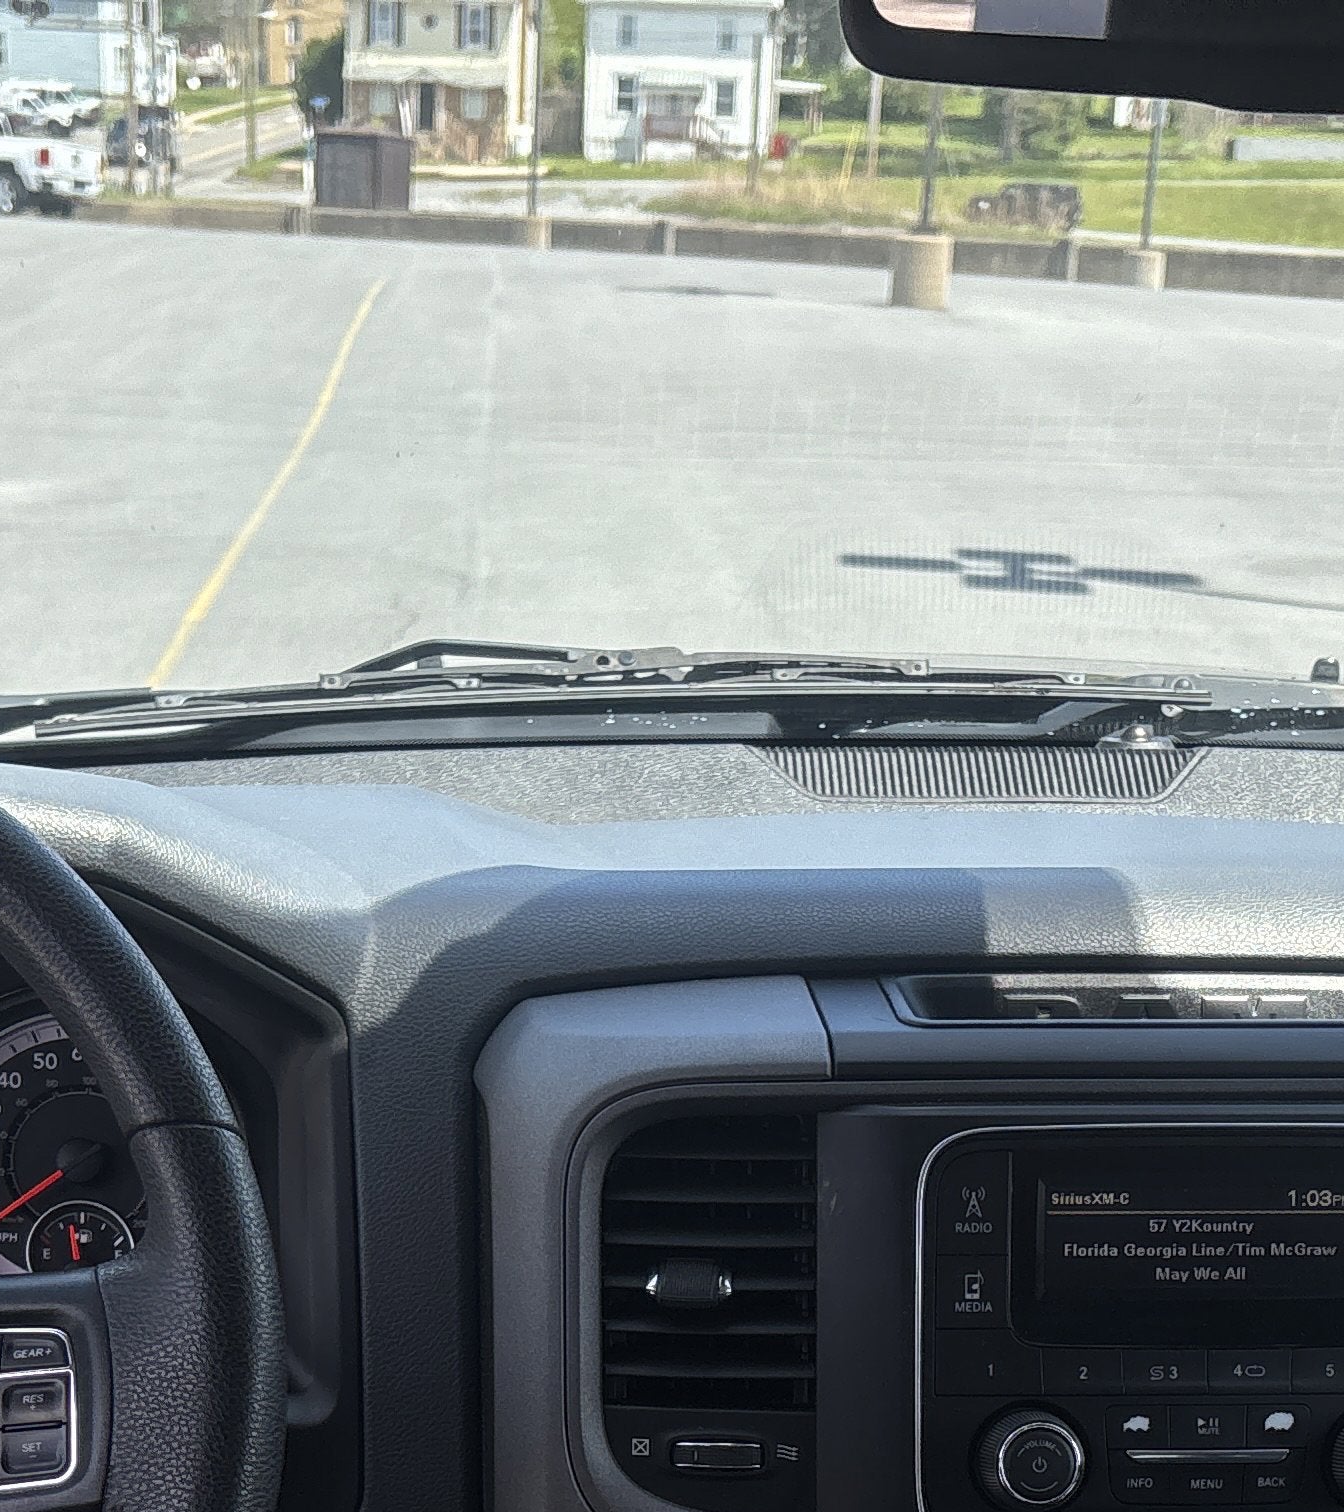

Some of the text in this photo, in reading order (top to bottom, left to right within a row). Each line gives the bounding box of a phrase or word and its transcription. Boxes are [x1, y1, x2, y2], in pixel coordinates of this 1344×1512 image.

[33, 1052, 58, 1070] 50
[1051, 1192, 1130, 1205] SiriusXM-C
[955, 1222, 993, 1233] RADIO
[1149, 1219, 1254, 1234] 57 Y2Kountry
[42, 1247, 51, 1260] E
[1064, 1243, 1118, 1257] Florida
[1123, 1243, 1187, 1259] Georgia
[1270, 1243, 1337, 1257] McGraw
[1155, 1267, 1246, 1282] May We All
[955, 1302, 993, 1313] MEDIA
[987, 1363, 994, 1376] 1
[1079, 1366, 1088, 1380] 2
[1169, 1366, 1179, 1379] 3
[1233, 1364, 1243, 1377] 4
[1325, 1364, 1335, 1377] 5
[22, 1394, 44, 1405] RES
[1198, 1427, 1220, 1435] MUTE
[21, 1441, 43, 1453] SET
[1126, 1477, 1154, 1488] INFO
[1190, 1479, 1224, 1490] MENU
[1258, 1477, 1286, 1487] BACK
